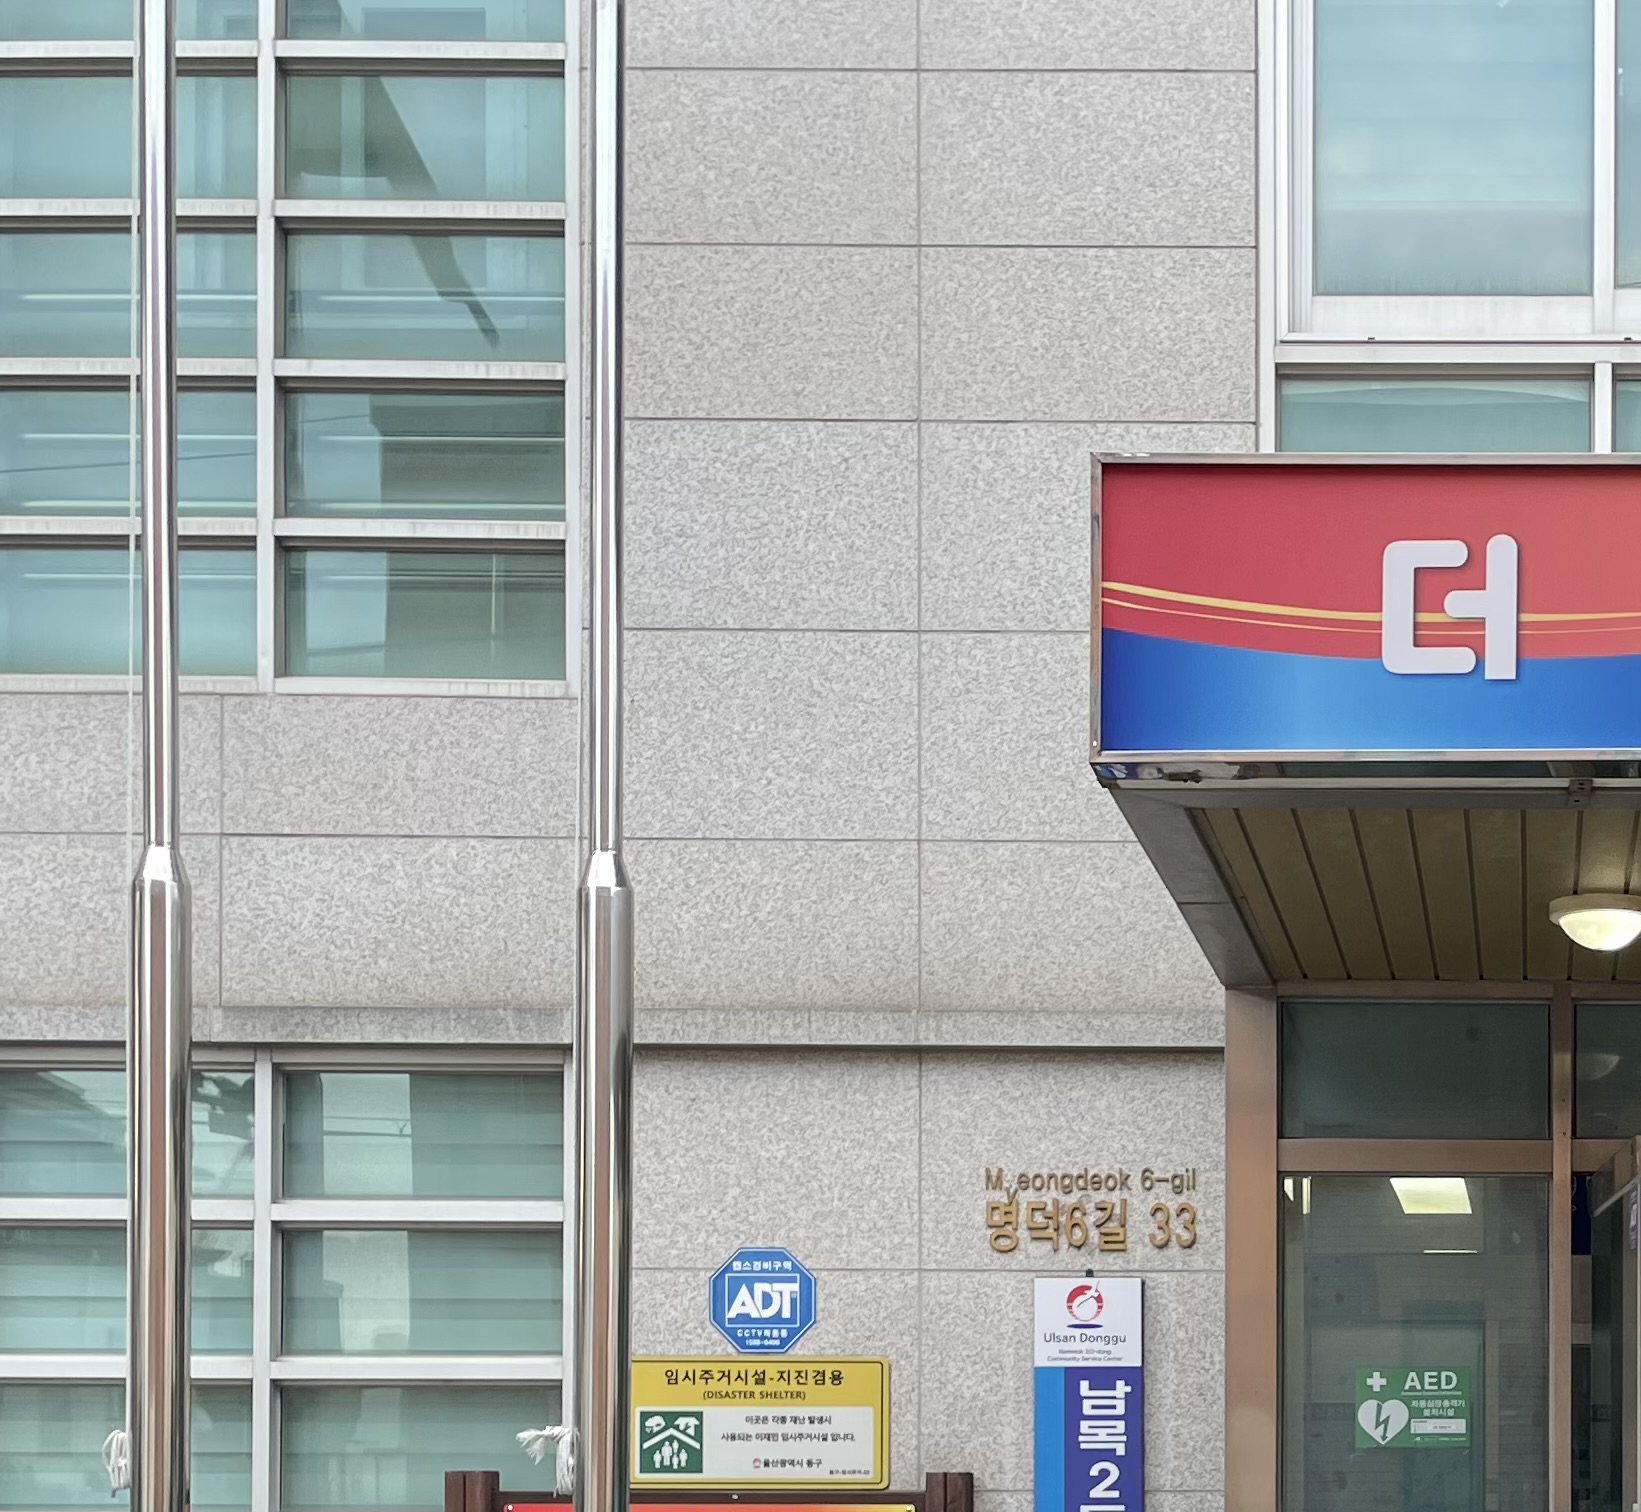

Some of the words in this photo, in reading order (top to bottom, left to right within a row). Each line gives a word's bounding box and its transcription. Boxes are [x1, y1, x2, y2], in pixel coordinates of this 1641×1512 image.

[1382, 533, 1519, 680] 더
[1141, 1167, 1197, 1194] 6-gil
[986, 1199, 1128, 1253] 명덕6길
[1149, 1201, 1198, 1249] 33
[727, 1282, 799, 1319] ADT
[1044, 1332, 1077, 1343] Ulsan
[1079, 1332, 1127, 1346] Donggu
[664, 1368, 845, 1386] 임시주거시설-지진겸용
[1403, 1371, 1458, 1390] AED
[702, 1390, 756, 1401] (DISASTER
[759, 1390, 806, 1401] SHELTER)
